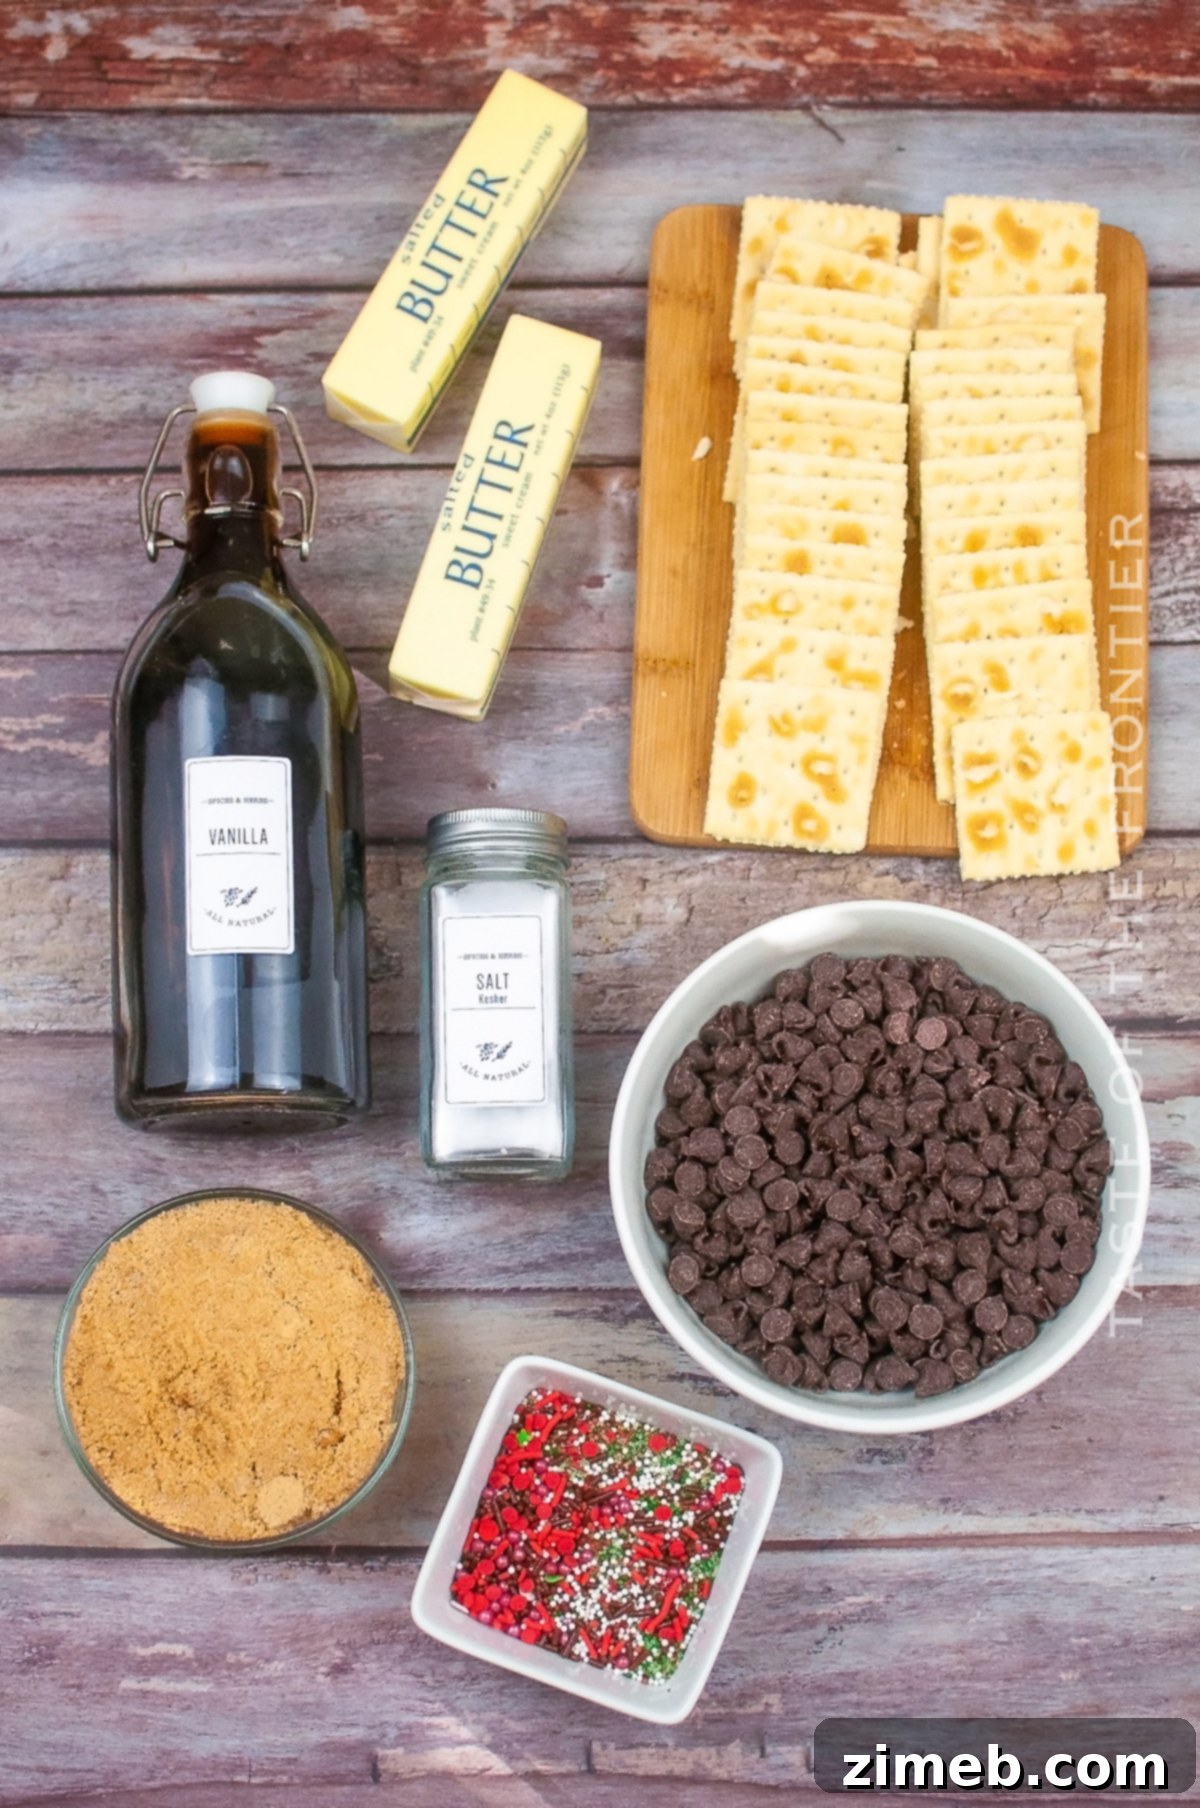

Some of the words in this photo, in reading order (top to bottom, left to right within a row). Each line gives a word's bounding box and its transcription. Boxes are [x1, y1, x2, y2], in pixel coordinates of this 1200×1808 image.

[396, 168, 508, 323] BUTTER
[401, 192, 446, 265] salted
[456, 257, 478, 289] sweet
[476, 221, 499, 255] cream
[441, 452, 476, 532] salted
[444, 420, 534, 590] BUTTER
[501, 513, 520, 548] sweet
[515, 471, 533, 510] cream
[469, 616, 484, 643] plant
[208, 827, 269, 846] VANILLA
[227, 907, 274, 928] NATURAL
[476, 972, 510, 990] SALT
[483, 1061, 530, 1081] NATURAL
